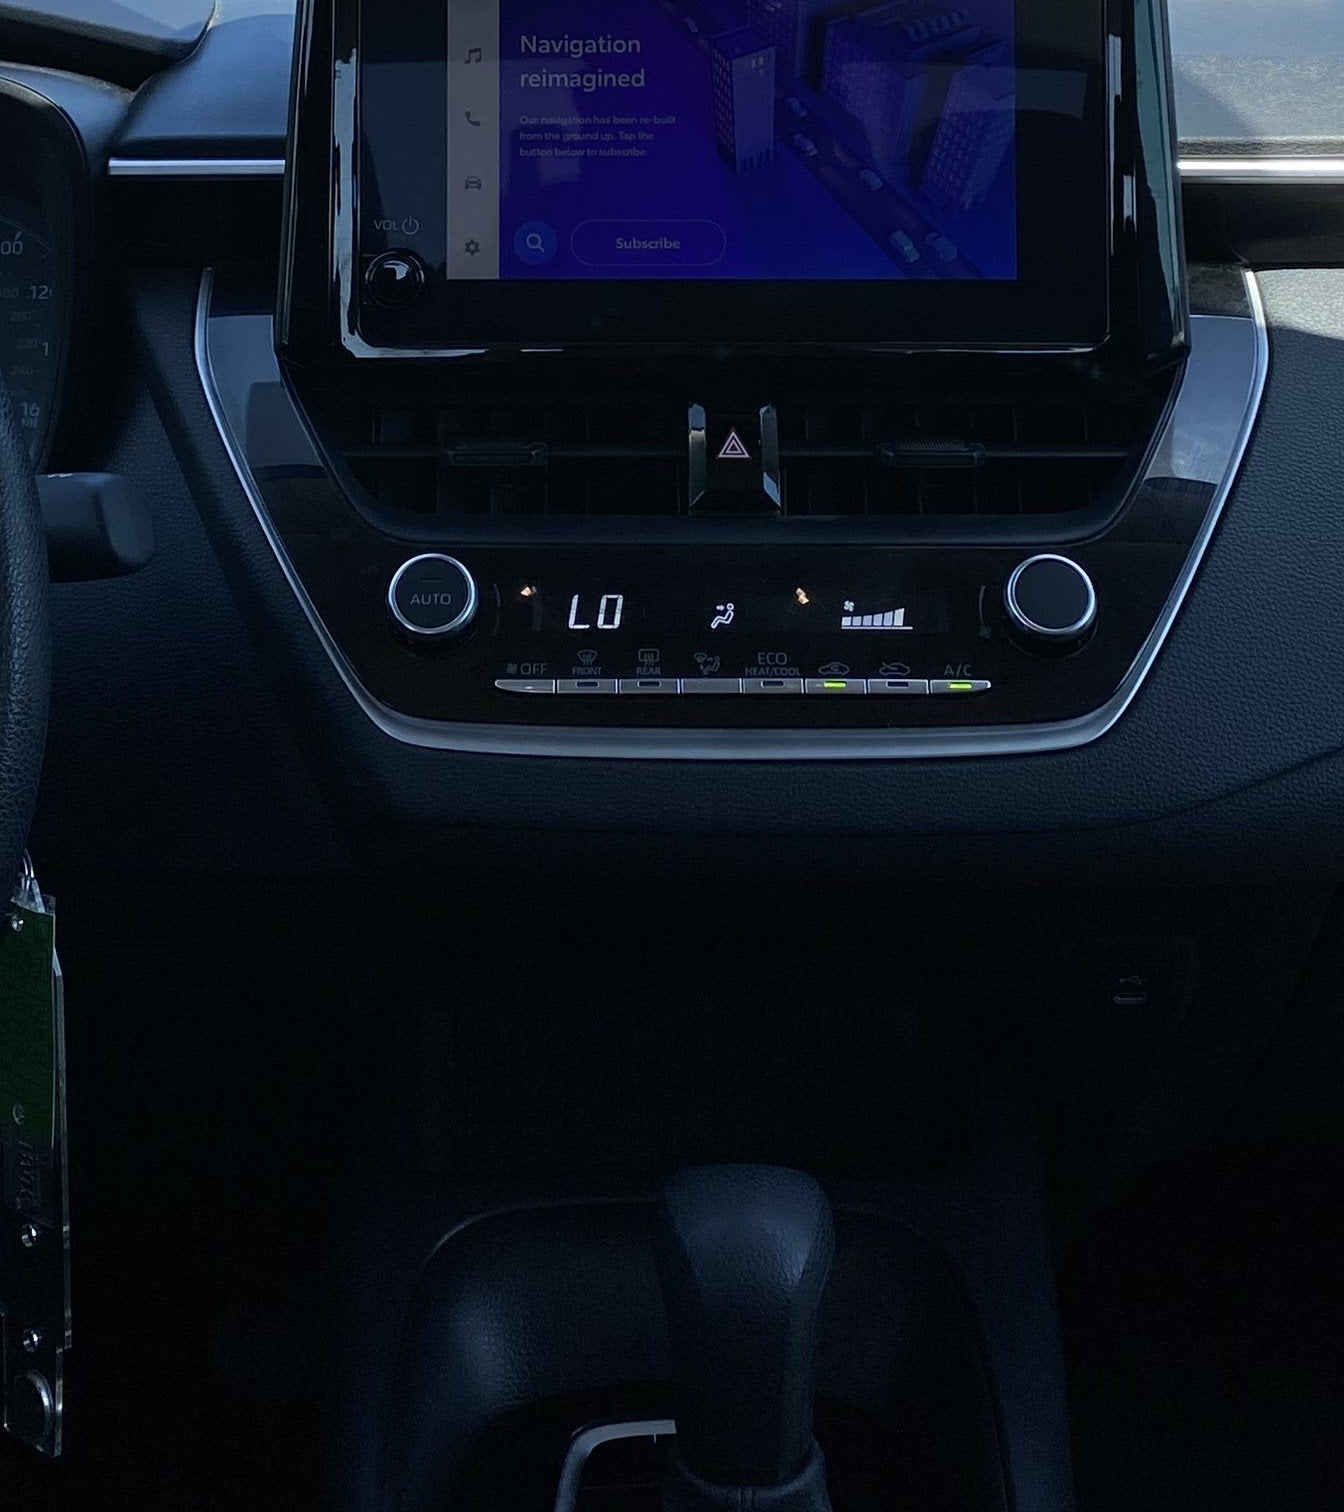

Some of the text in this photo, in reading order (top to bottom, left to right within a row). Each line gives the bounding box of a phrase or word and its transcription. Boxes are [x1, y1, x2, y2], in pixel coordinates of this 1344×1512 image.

[520, 33, 641, 58] Navigation
[520, 68, 645, 92] reimagined
[519, 115, 676, 127] Our navigation has been re-built
[519, 131, 654, 143] from the ground up. Tap the
[519, 147, 648, 157] button below to subscribe.
[373, 219, 399, 231] VOL
[615, 237, 681, 250] Subscribe
[30, 285, 52, 300] 12
[21, 402, 40, 417] 16
[409, 593, 453, 606] AUTO
[568, 594, 624, 630] LO
[757, 652, 788, 665] ECO
[520, 662, 548, 676] OFF
[571, 666, 603, 676] FRONT
[636, 666, 662, 676] REAR
[744, 666, 801, 677] HEAT/COOL
[944, 663, 973, 677] A/C
